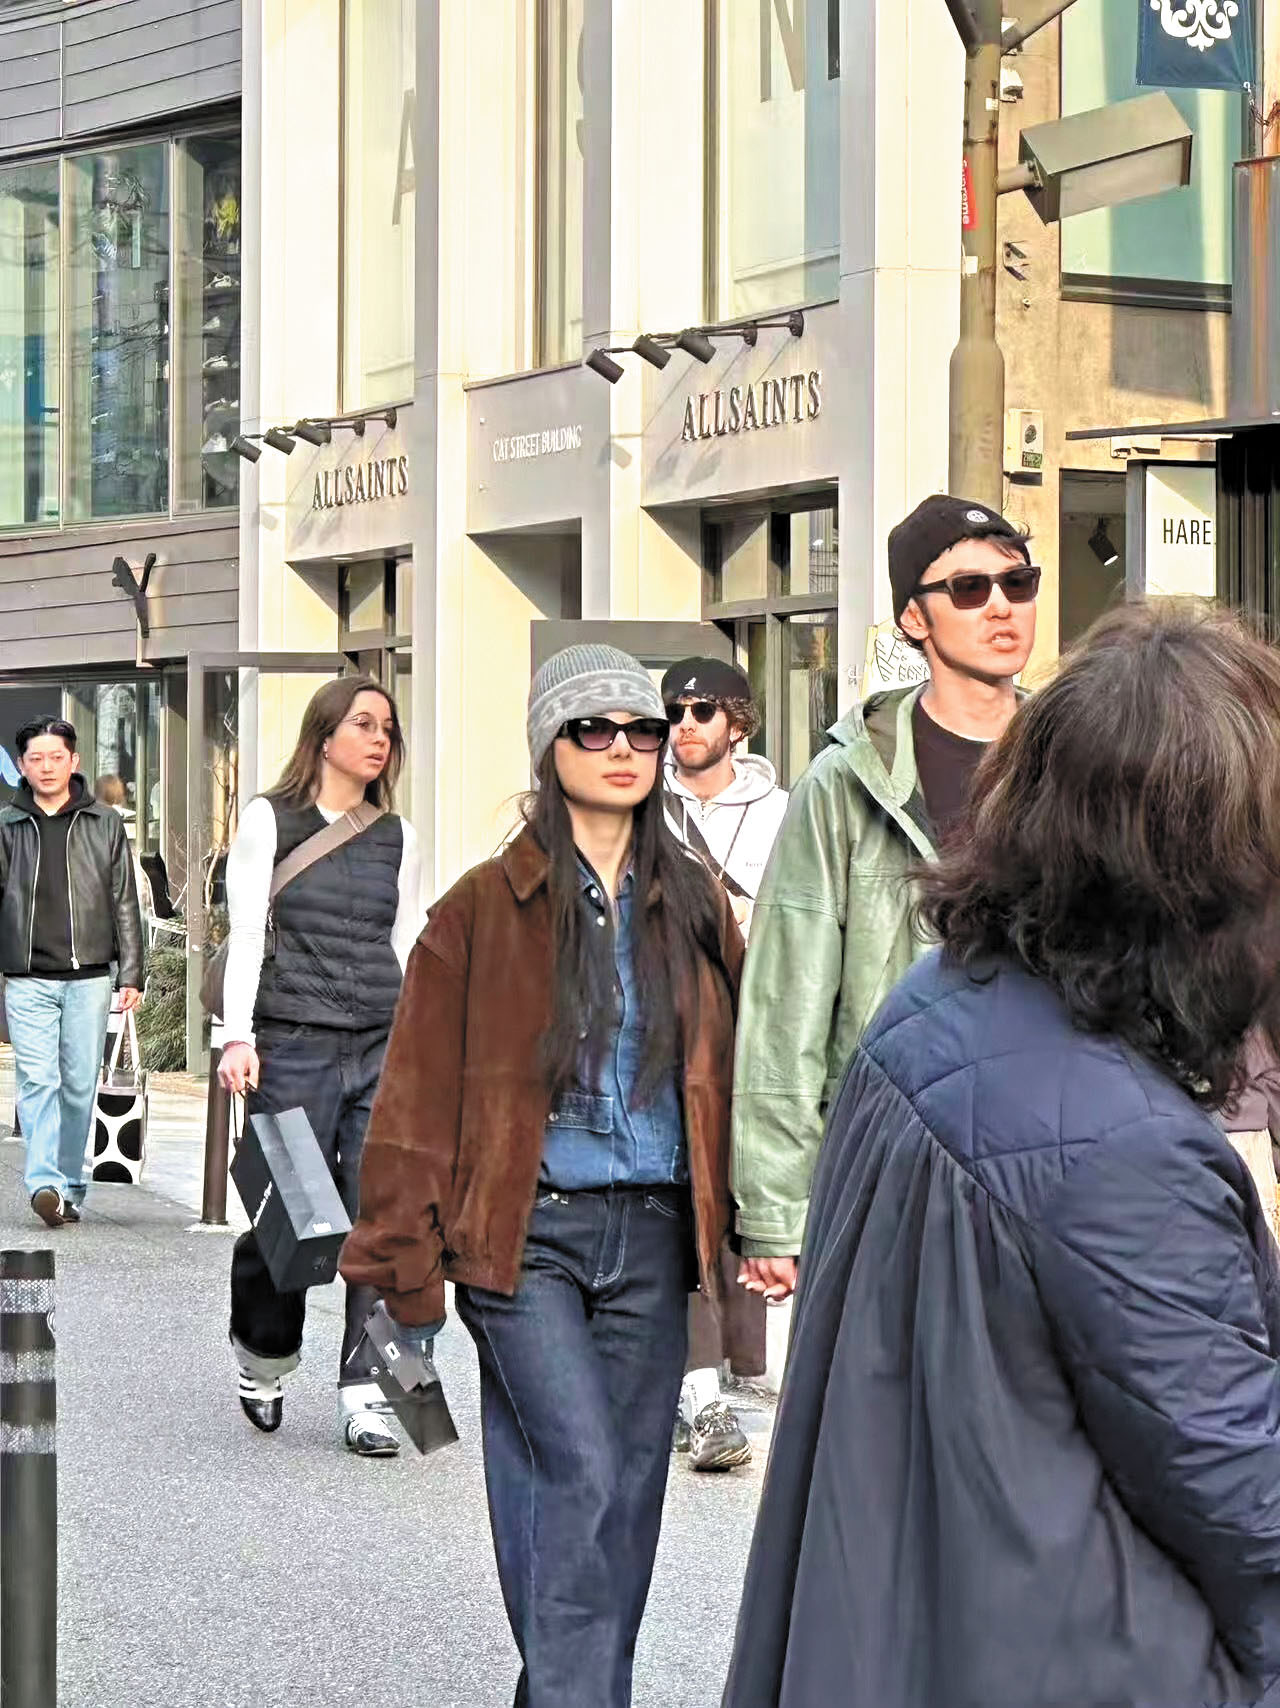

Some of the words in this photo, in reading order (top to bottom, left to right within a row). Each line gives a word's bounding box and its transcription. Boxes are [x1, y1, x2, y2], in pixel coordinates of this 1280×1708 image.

[681, 370, 822, 441] ALLSAINTS
[493, 437, 509, 462] CAT
[510, 432, 540, 458] STREET
[541, 424, 582, 454] BUILDING
[312, 455, 409, 510] ALLSAINTS
[1163, 518, 1216, 545] HARE
